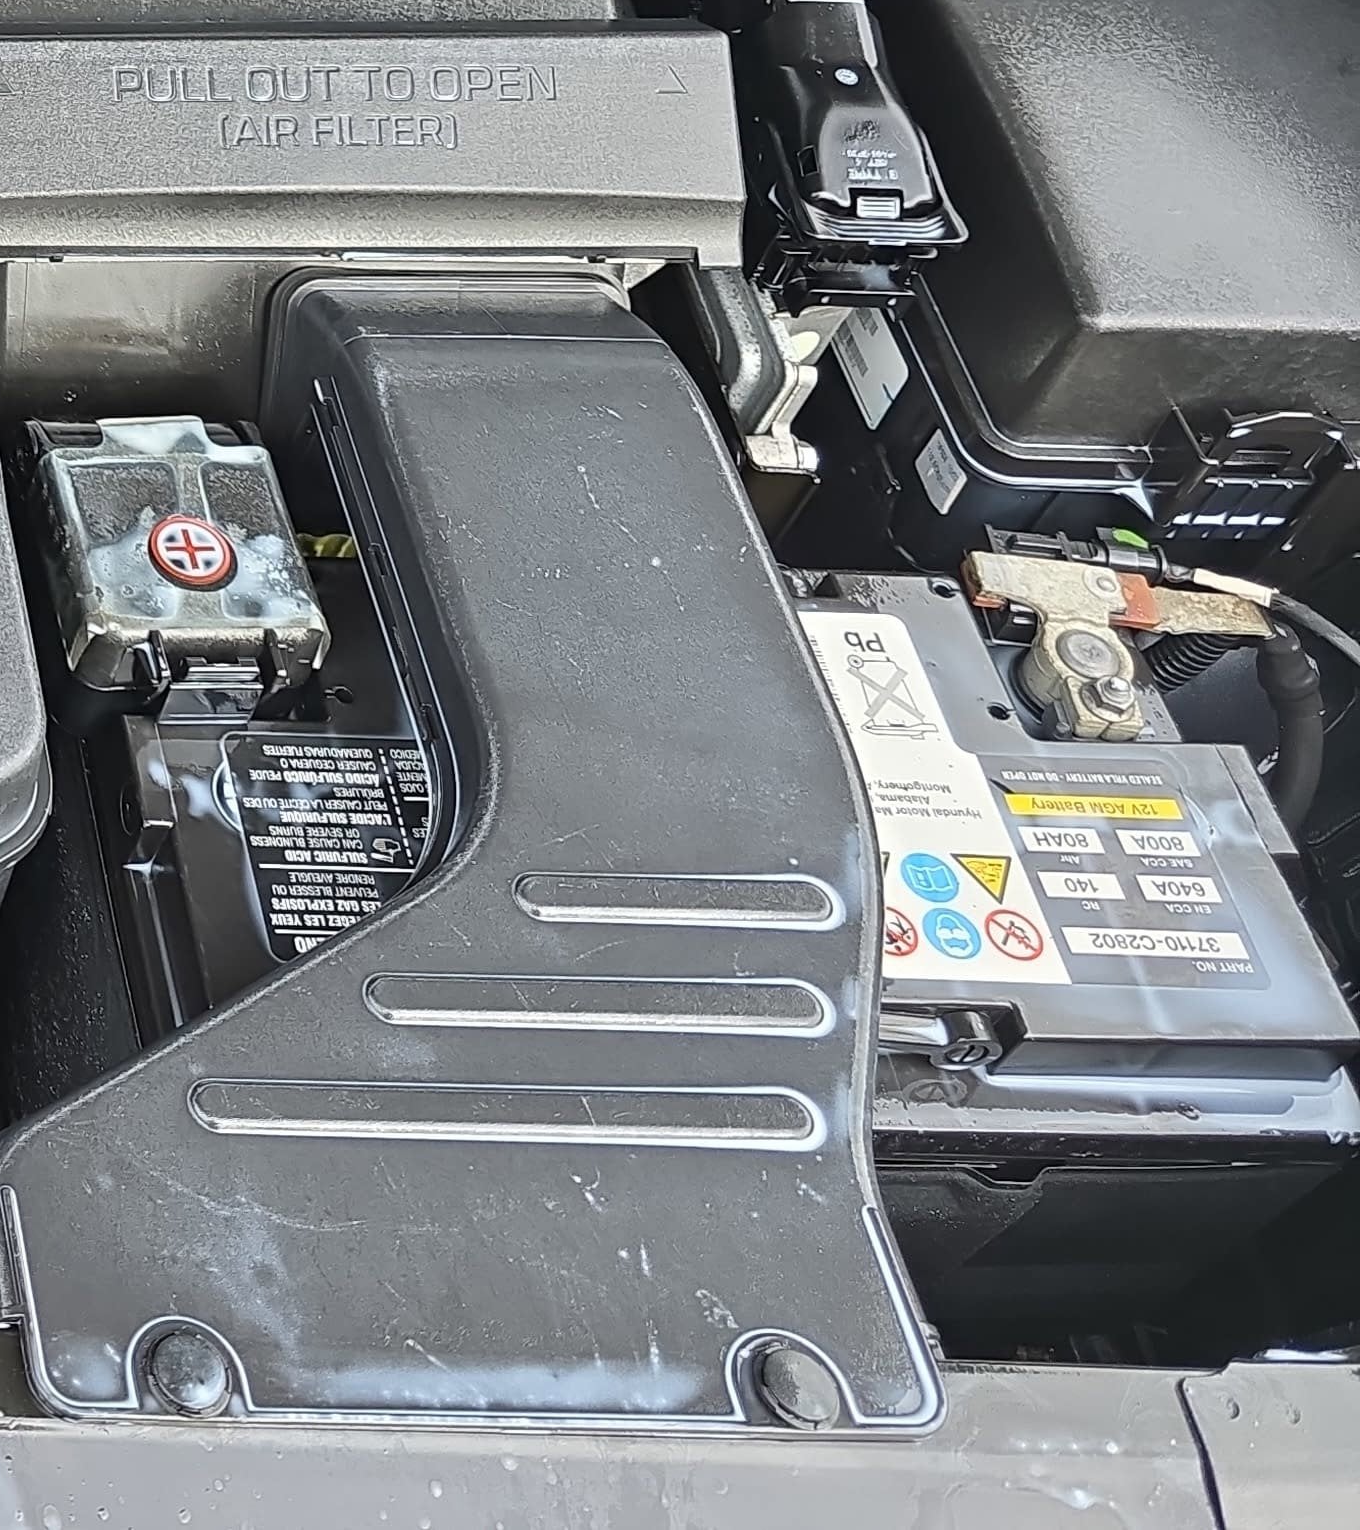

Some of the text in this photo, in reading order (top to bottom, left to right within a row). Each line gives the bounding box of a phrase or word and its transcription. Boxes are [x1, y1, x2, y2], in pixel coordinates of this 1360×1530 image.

[113, 65, 558, 102] PULL OUT TO OPEN
[218, 112, 459, 150] (AIR FILTER)
[843, 630, 886, 654] Pb
[263, 745, 373, 759] QUEMADURAS FUERTES
[280, 758, 376, 771] CAUSER CEGUERA O
[284, 771, 344, 785] SULFÚRICO
[345, 773, 380, 787] ÁCIDO
[1001, 770, 1026, 781] OPEN
[1026, 771, 1045, 782] NOT
[1045, 772, 1060, 782] DO
[1066, 772, 1106, 784] BATTERY
[243, 797, 261, 808] DES
[262, 798, 278, 808] OU
[313, 799, 326, 810] LA
[326, 799, 362, 811] CAUSER
[875, 792, 930, 805] Alabama,
[364, 800, 388, 811] PEUT
[896, 805, 931, 818] Motor
[1031, 798, 1159, 815] 12V AGM Battery
[280, 811, 392, 826] L'ACIDE SULFURIQUE
[931, 806, 983, 819] Hyundai
[269, 825, 360, 838] OR SEVERE BURNS
[250, 835, 363, 849] CAN CAUSE BLINDNESS
[1032, 831, 1089, 847] 80AH
[1130, 835, 1185, 851] 800A
[284, 849, 368, 864] SULFURIC ACID
[1060, 854, 1081, 865] Ahr
[1140, 857, 1194, 869] SAE CCA
[288, 872, 375, 885] RENDRE AVEUGLE
[1064, 877, 1099, 893] 140
[272, 884, 379, 898] PEUVENT BLESSER OU
[1151, 880, 1207, 898] 640A
[271, 898, 336, 911] EXPLOSIFS
[336, 899, 360, 911] GAZ
[1082, 901, 1101, 911] RC
[1165, 903, 1213, 915] EN CCA
[269, 913, 302, 926] YEUX
[303, 914, 326, 927] LES
[1087, 931, 1222, 954] 37110-C2802
[1191, 960, 1255, 974] PART NO.
